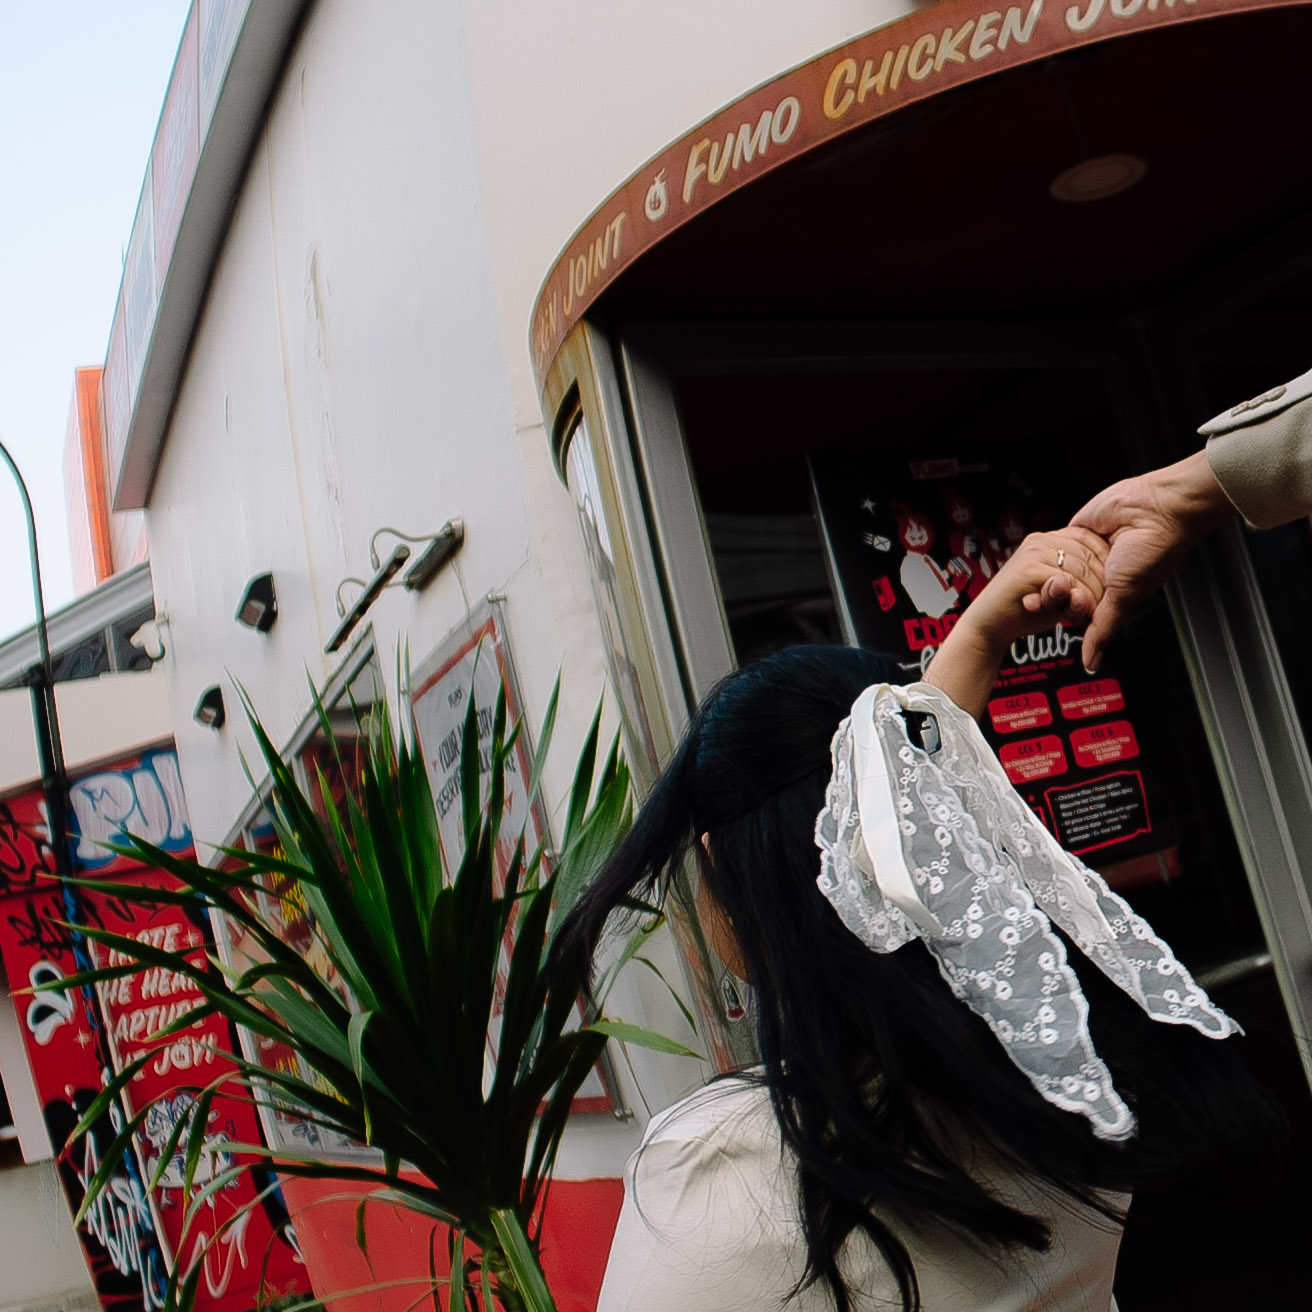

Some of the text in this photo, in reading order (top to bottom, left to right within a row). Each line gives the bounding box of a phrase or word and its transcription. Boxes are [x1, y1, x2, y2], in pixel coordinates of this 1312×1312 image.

[563, 211, 627, 317] JOINT
[682, 95, 800, 203] FUMO
[1010, 622, 1070, 665] Club
